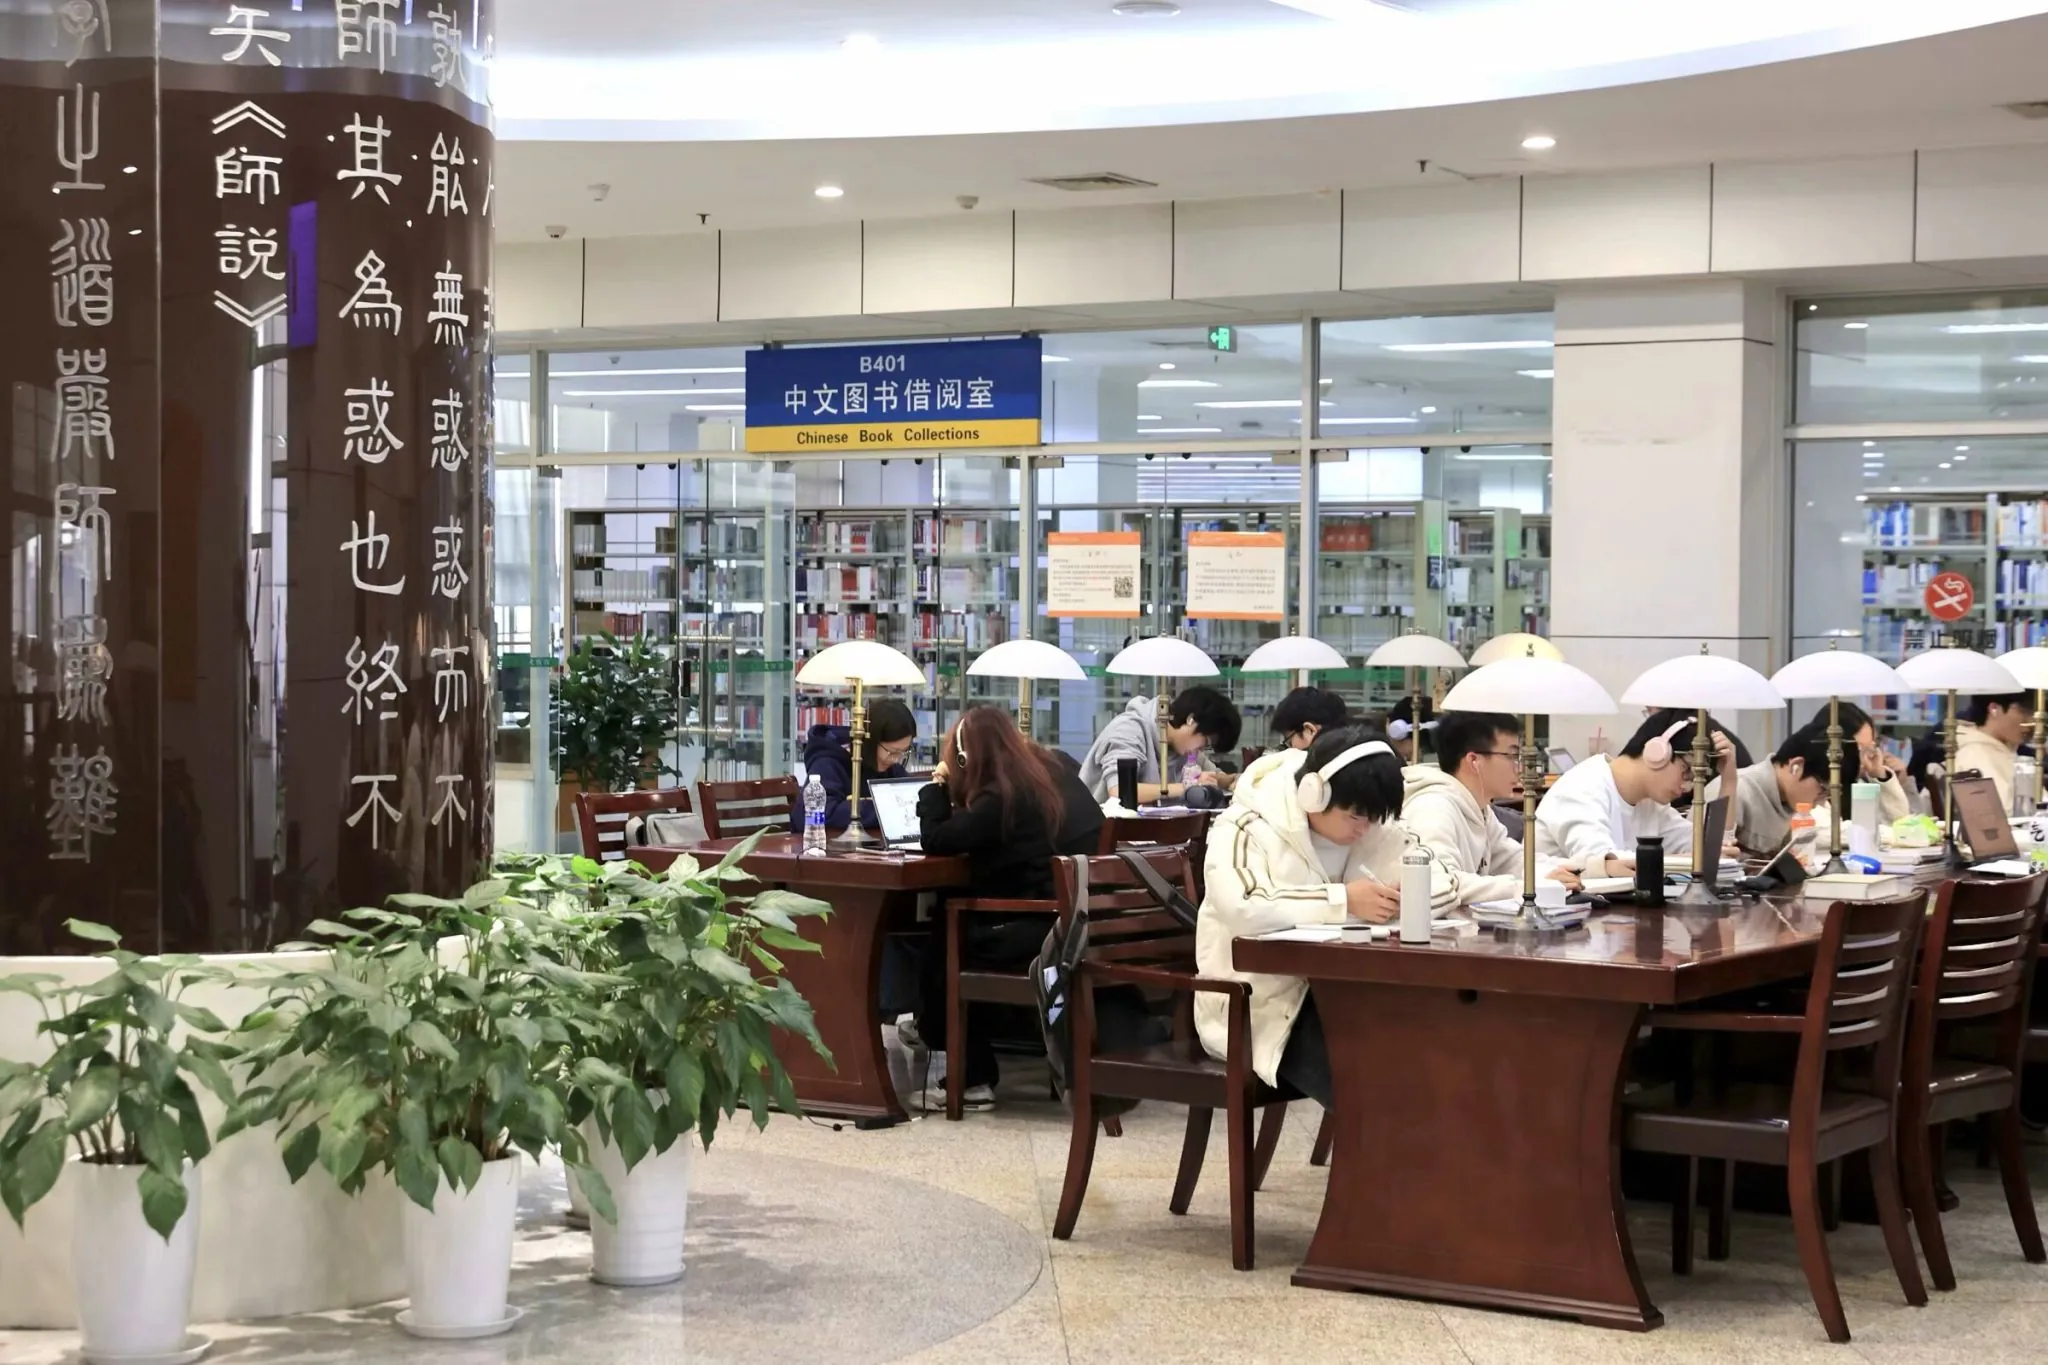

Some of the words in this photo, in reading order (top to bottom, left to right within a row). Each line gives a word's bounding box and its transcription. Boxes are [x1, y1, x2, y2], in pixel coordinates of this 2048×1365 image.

[859, 355, 906, 373] B401
[784, 376, 995, 416] 中文图书借阅室
[796, 432, 849, 445] Chinese
[859, 430, 893, 443] Book
[903, 427, 980, 441] Collections
